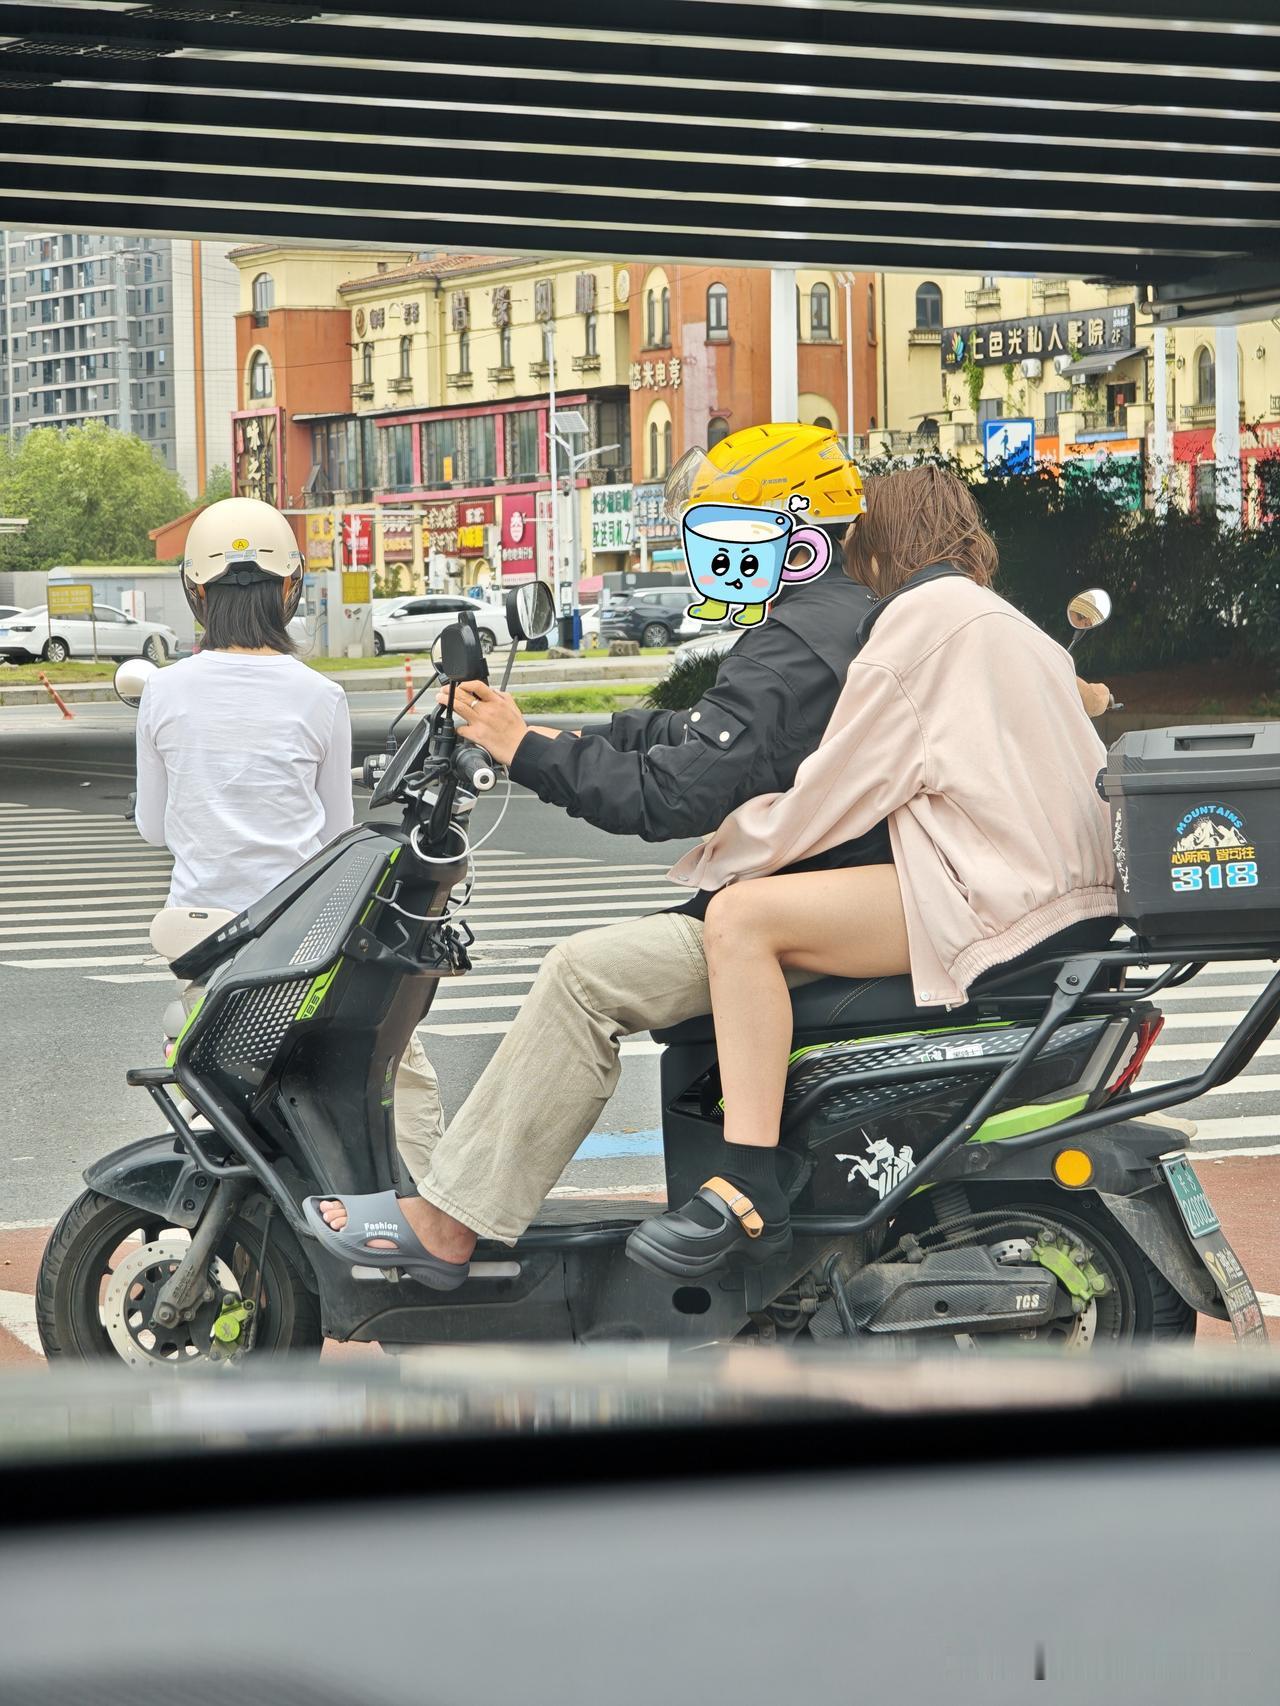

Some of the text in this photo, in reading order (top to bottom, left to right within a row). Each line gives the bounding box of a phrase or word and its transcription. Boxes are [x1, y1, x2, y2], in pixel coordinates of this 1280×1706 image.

[972, 319, 1104, 359] 七色光私人影院
[1111, 329, 1121, 343] 2F
[1176, 805, 1243, 835] MOUNTAINS
[1172, 847, 1256, 864] 心所向 皆可往
[1171, 862, 1258, 892] 318
[364, 1221, 398, 1231] Fashion
[1016, 1294, 1040, 1310] TCS
